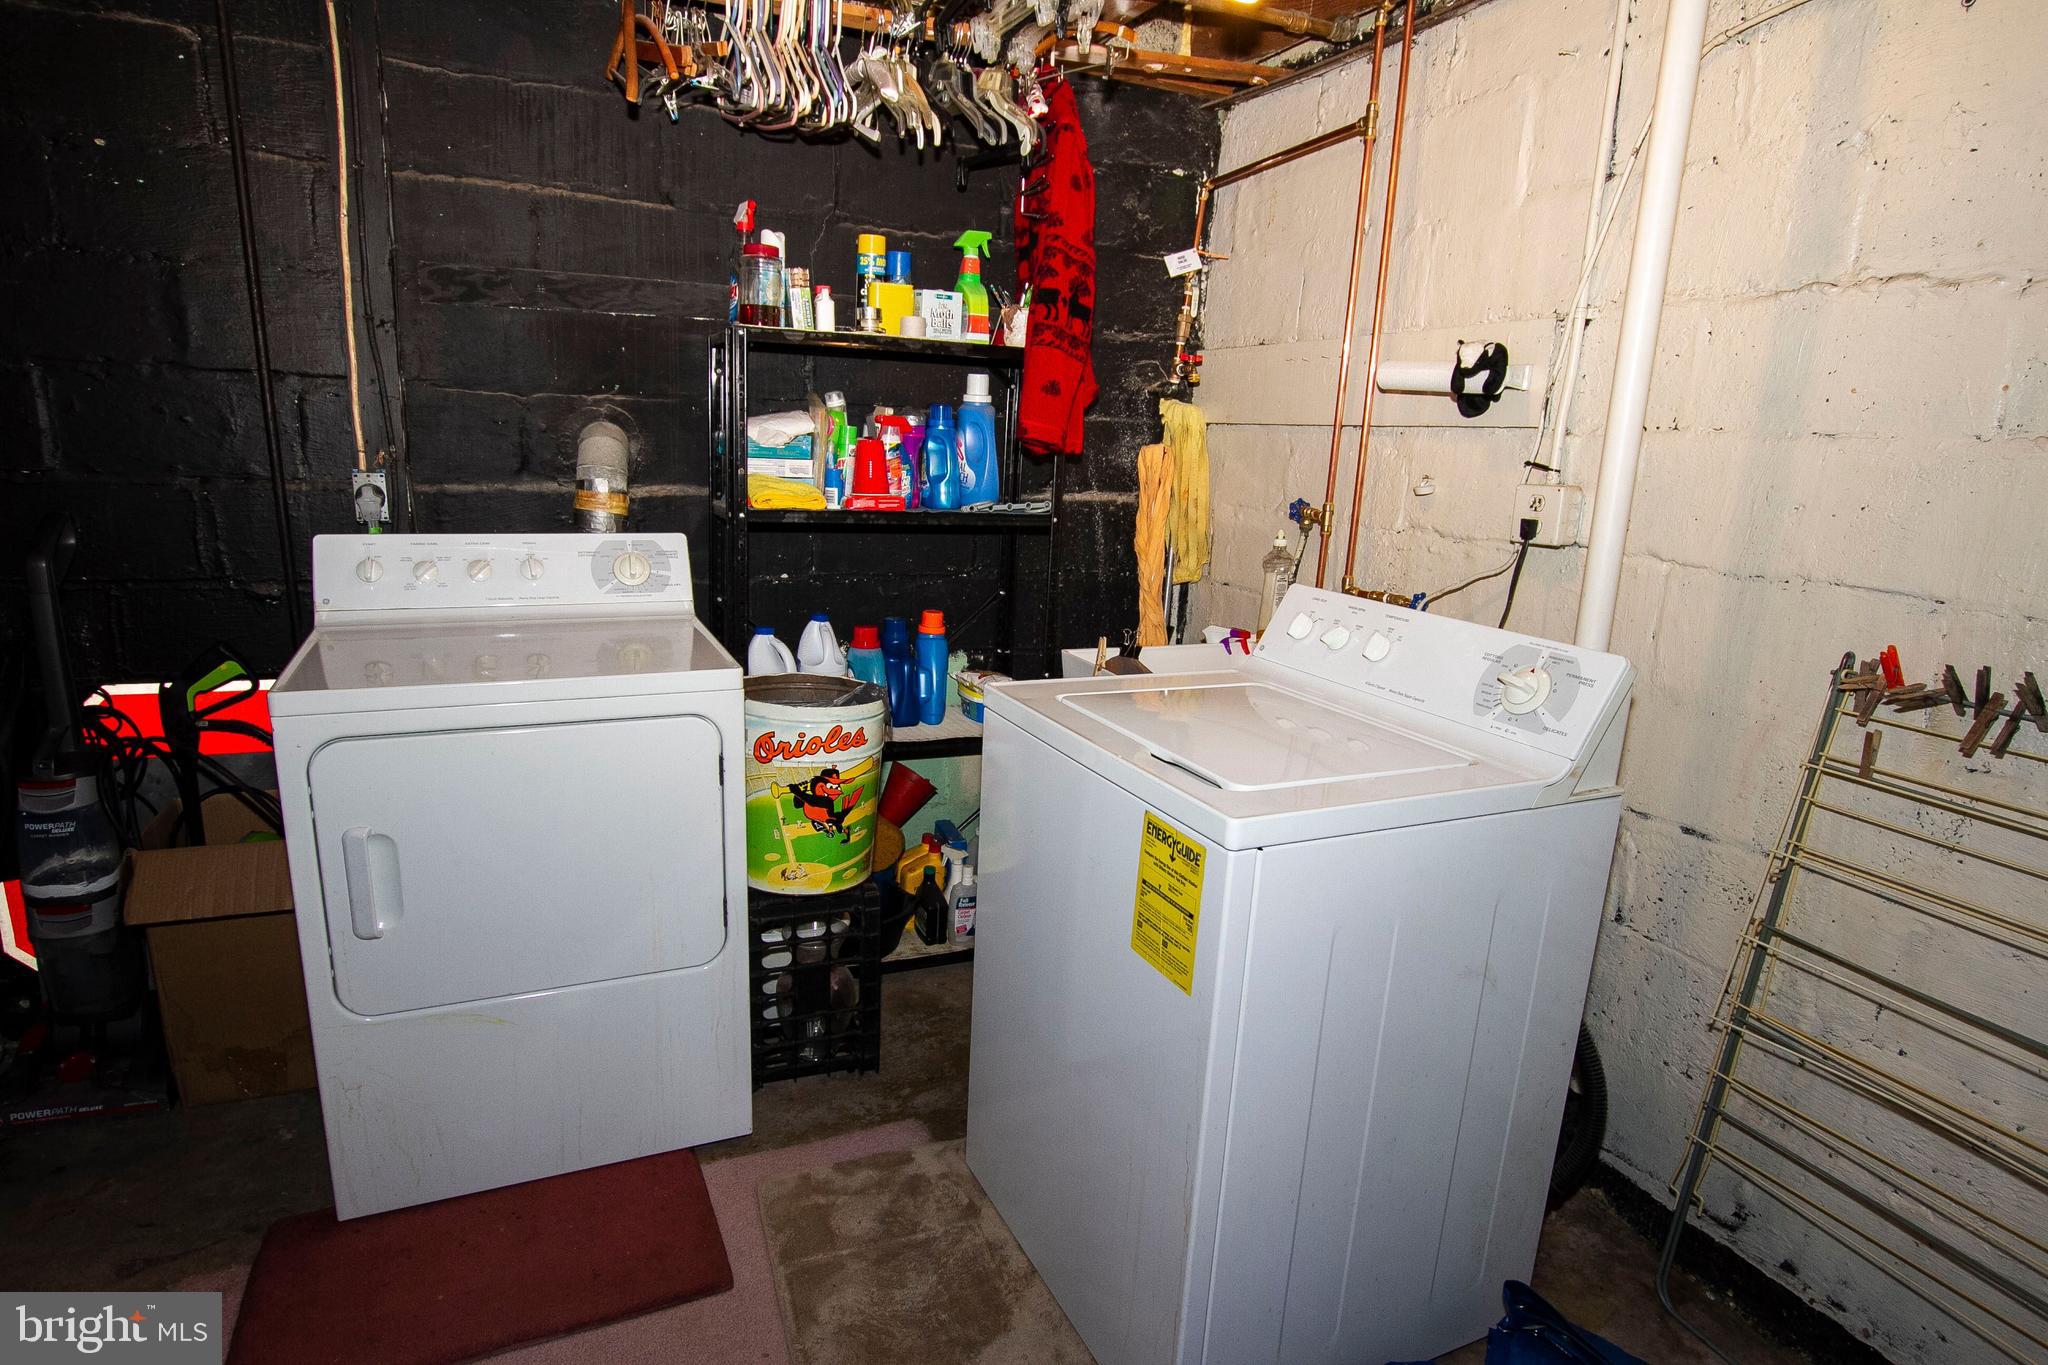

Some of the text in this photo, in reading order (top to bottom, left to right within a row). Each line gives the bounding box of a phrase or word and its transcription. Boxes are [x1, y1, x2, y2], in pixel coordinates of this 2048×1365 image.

[930, 307, 954, 319] Moth
[930, 318, 952, 330] Balls
[1566, 672, 1597, 684] PERMANENT
[1578, 680, 1595, 689] PRESS
[753, 725, 868, 764] Orioles
[24, 821, 77, 831] POWERPATH
[1146, 820, 1201, 867] ENERGYGUIDE
[9, 1104, 78, 1121] POWERPATH
